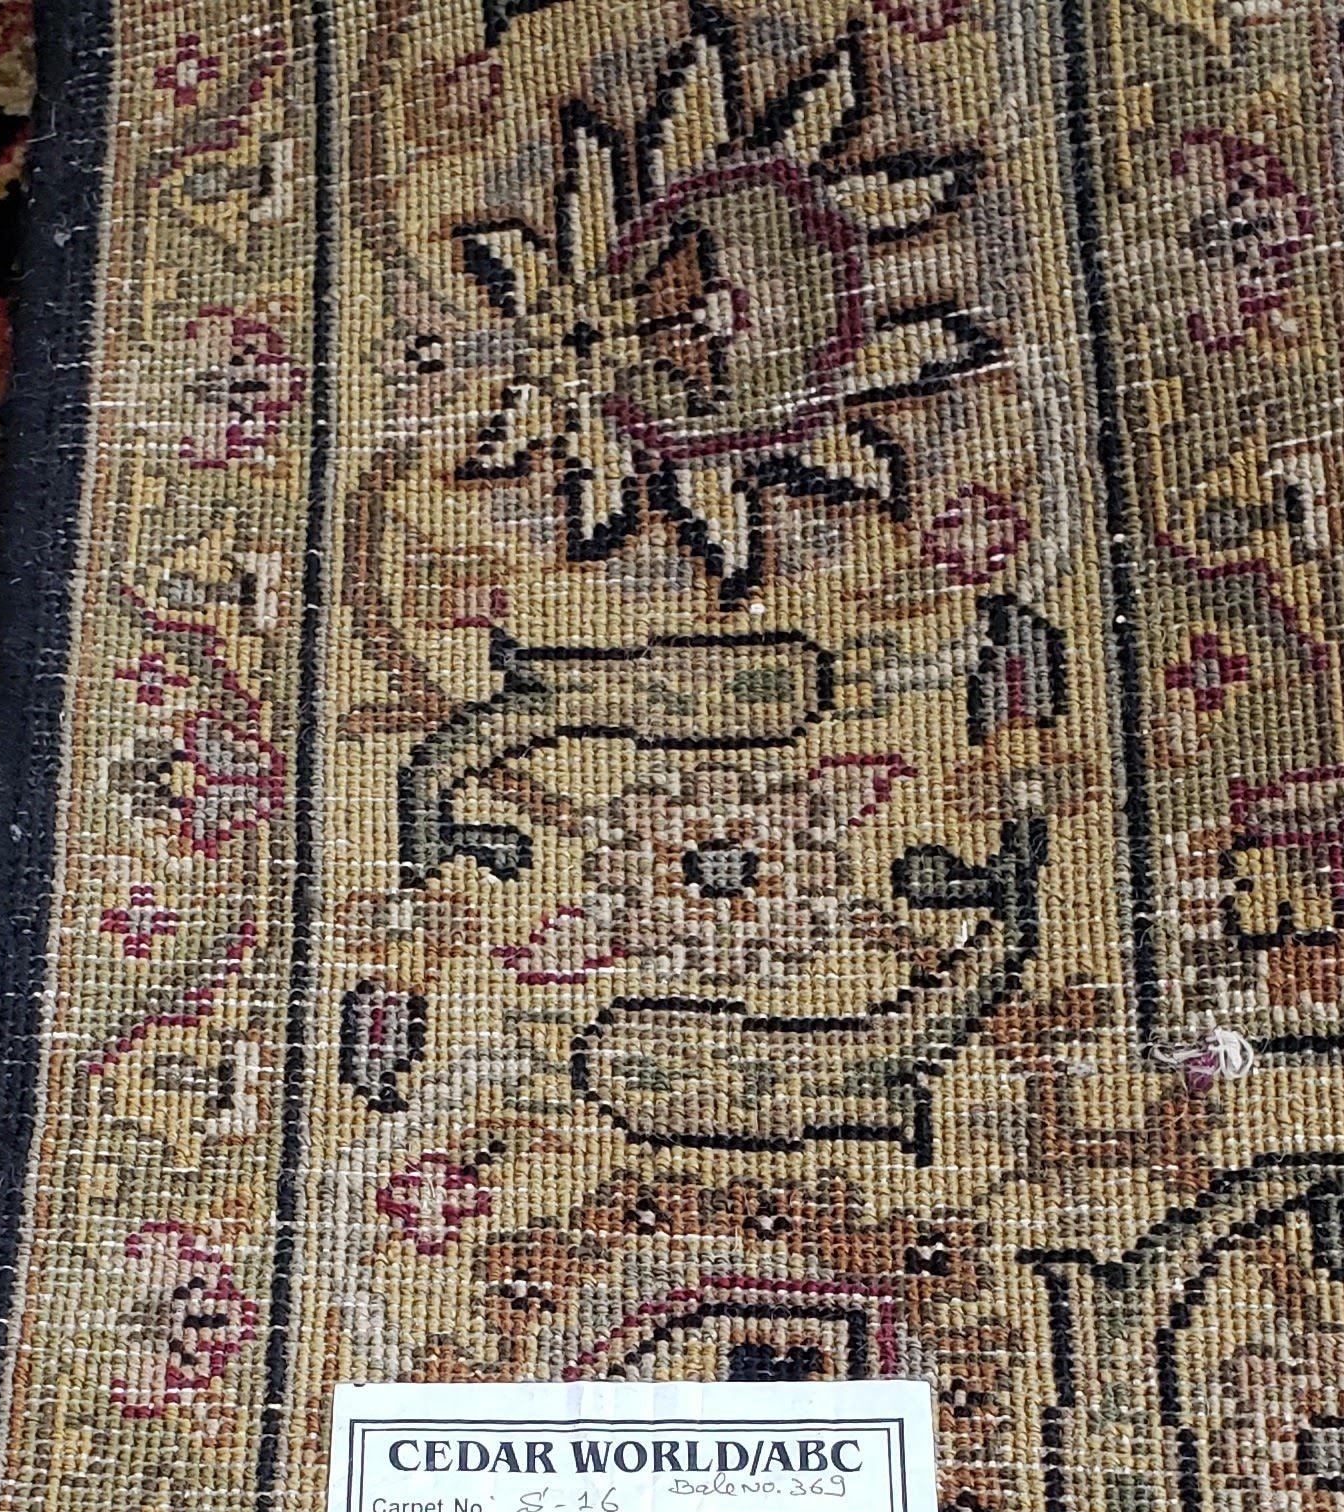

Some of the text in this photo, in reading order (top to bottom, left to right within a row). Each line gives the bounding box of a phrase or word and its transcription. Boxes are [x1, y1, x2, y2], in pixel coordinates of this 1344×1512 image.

[388, 1439, 863, 1476] CEDAR WORLD/ABC
[789, 1475, 846, 1497] 369
